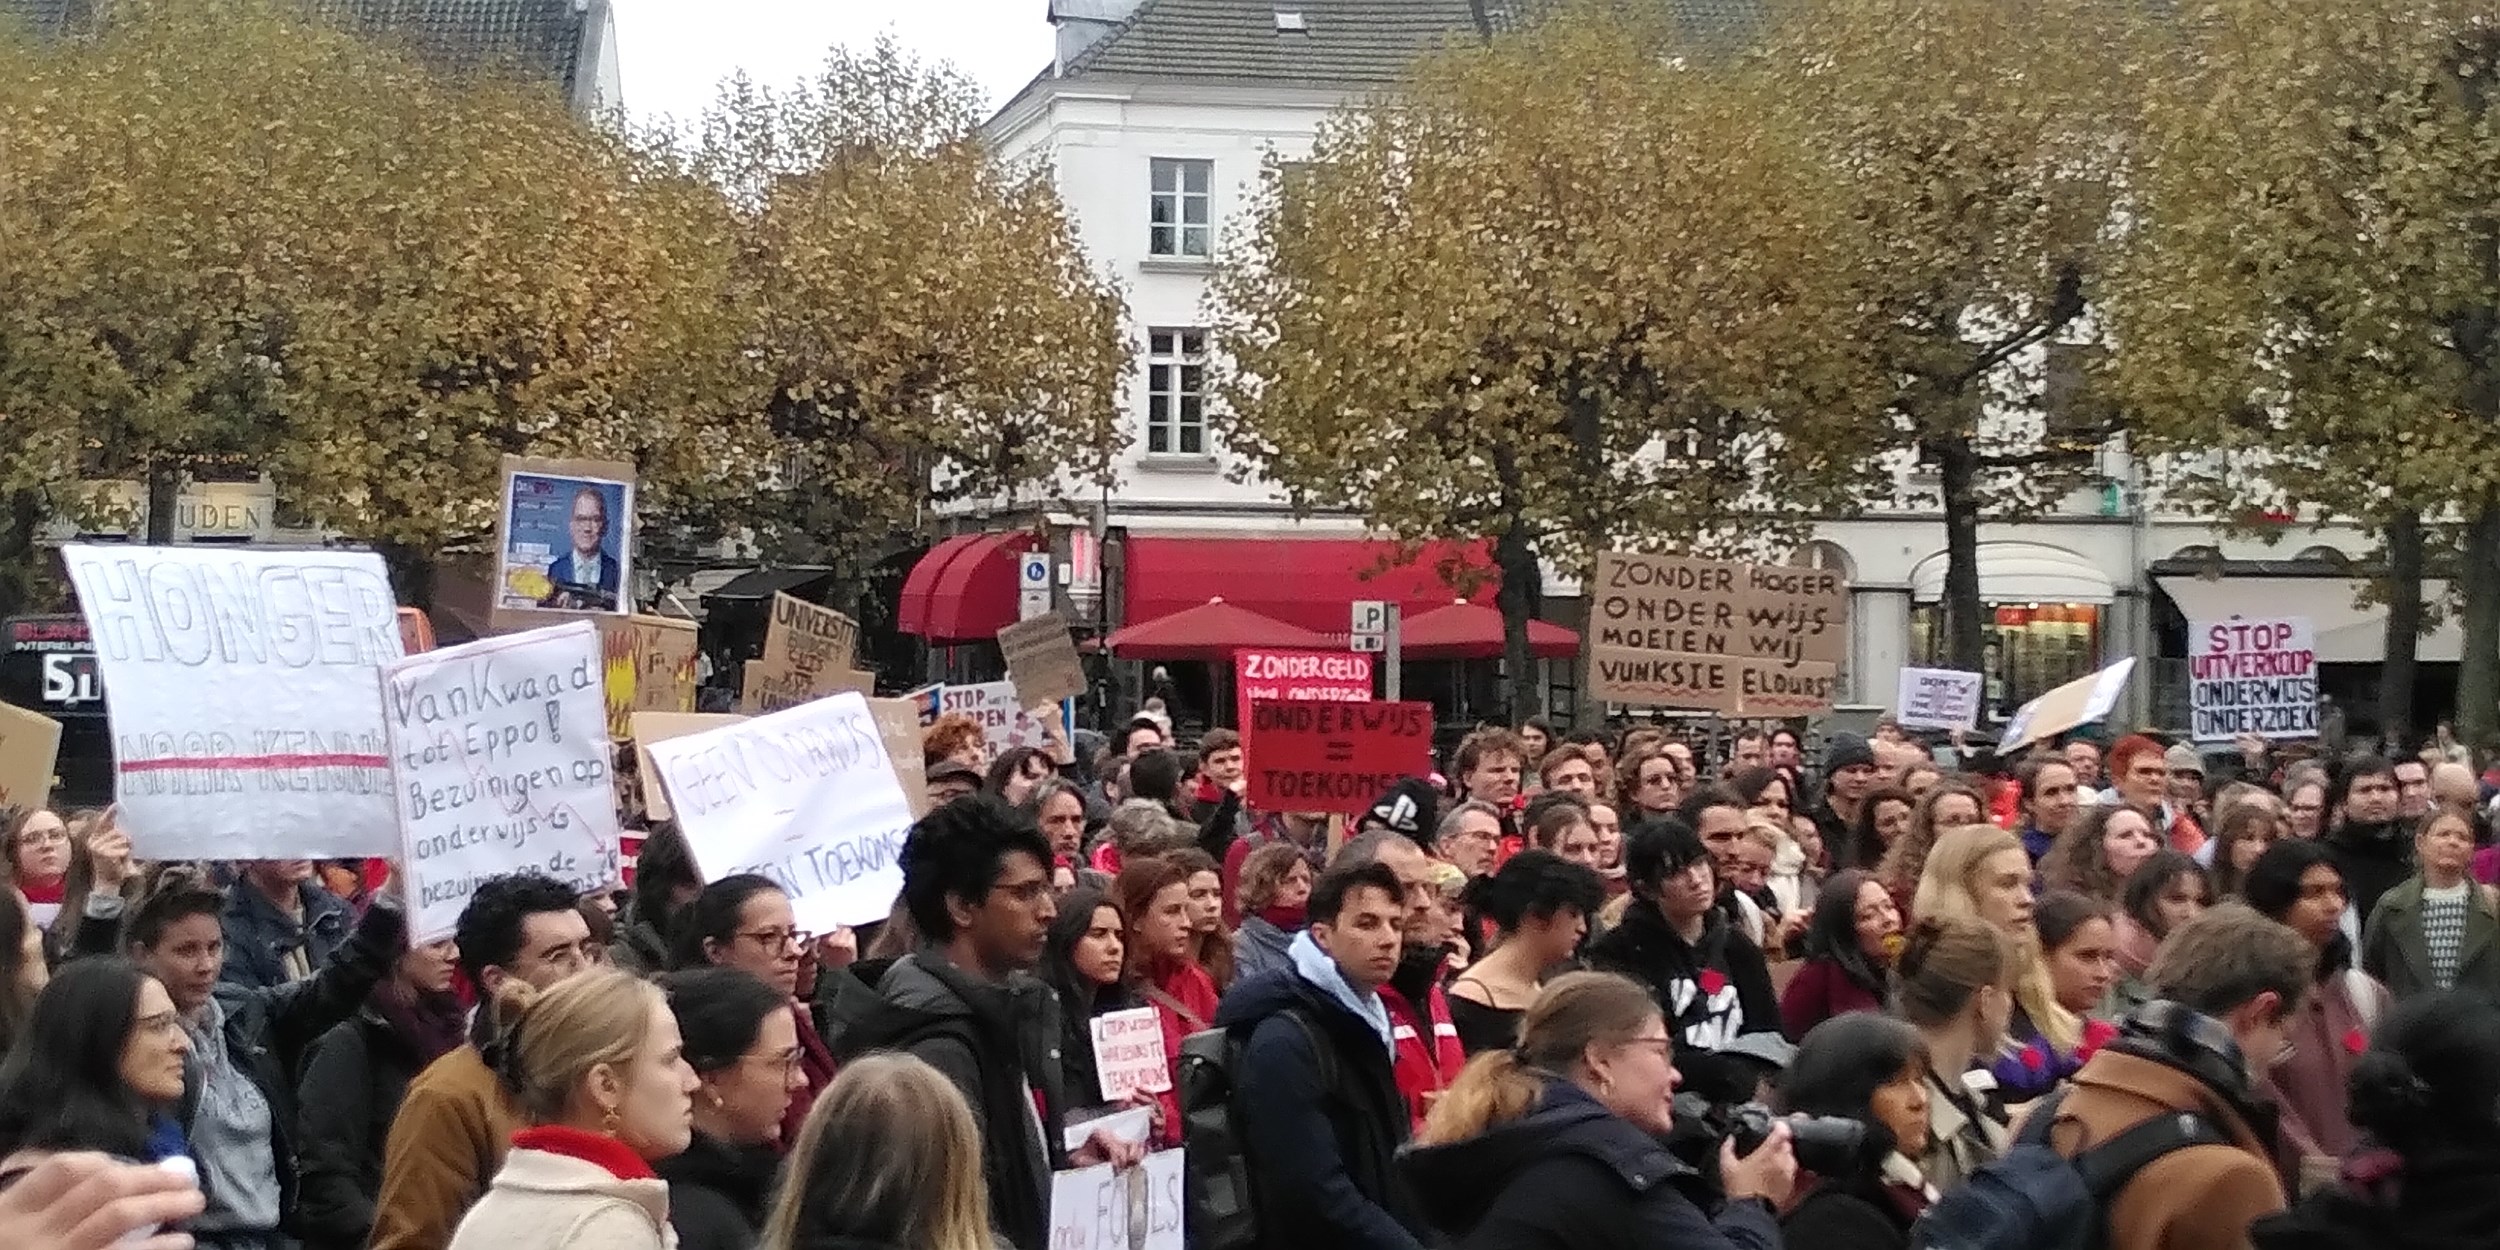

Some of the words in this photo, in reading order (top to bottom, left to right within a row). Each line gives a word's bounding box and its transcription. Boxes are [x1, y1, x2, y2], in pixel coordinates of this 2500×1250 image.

[179, 504, 261, 530] UDEN
[1609, 559, 1734, 594] ZONDER
[1750, 568, 1836, 596] HOGER
[81, 560, 400, 668] HONGER
[2209, 623, 2293, 652] STOP
[1245, 654, 1320, 680] ZONDER
[1321, 656, 1370, 682] GELD
[2190, 649, 2314, 680] UITVERKOOP
[943, 688, 986, 711] STOP
[403, 735, 449, 770] tot
[465, 699, 561, 763] Eppo!
[1256, 705, 1423, 738] ONDERWIJS
[2196, 705, 2316, 736] ONDERZOEK
[571, 758, 605, 788] op
[549, 849, 576, 873] de
